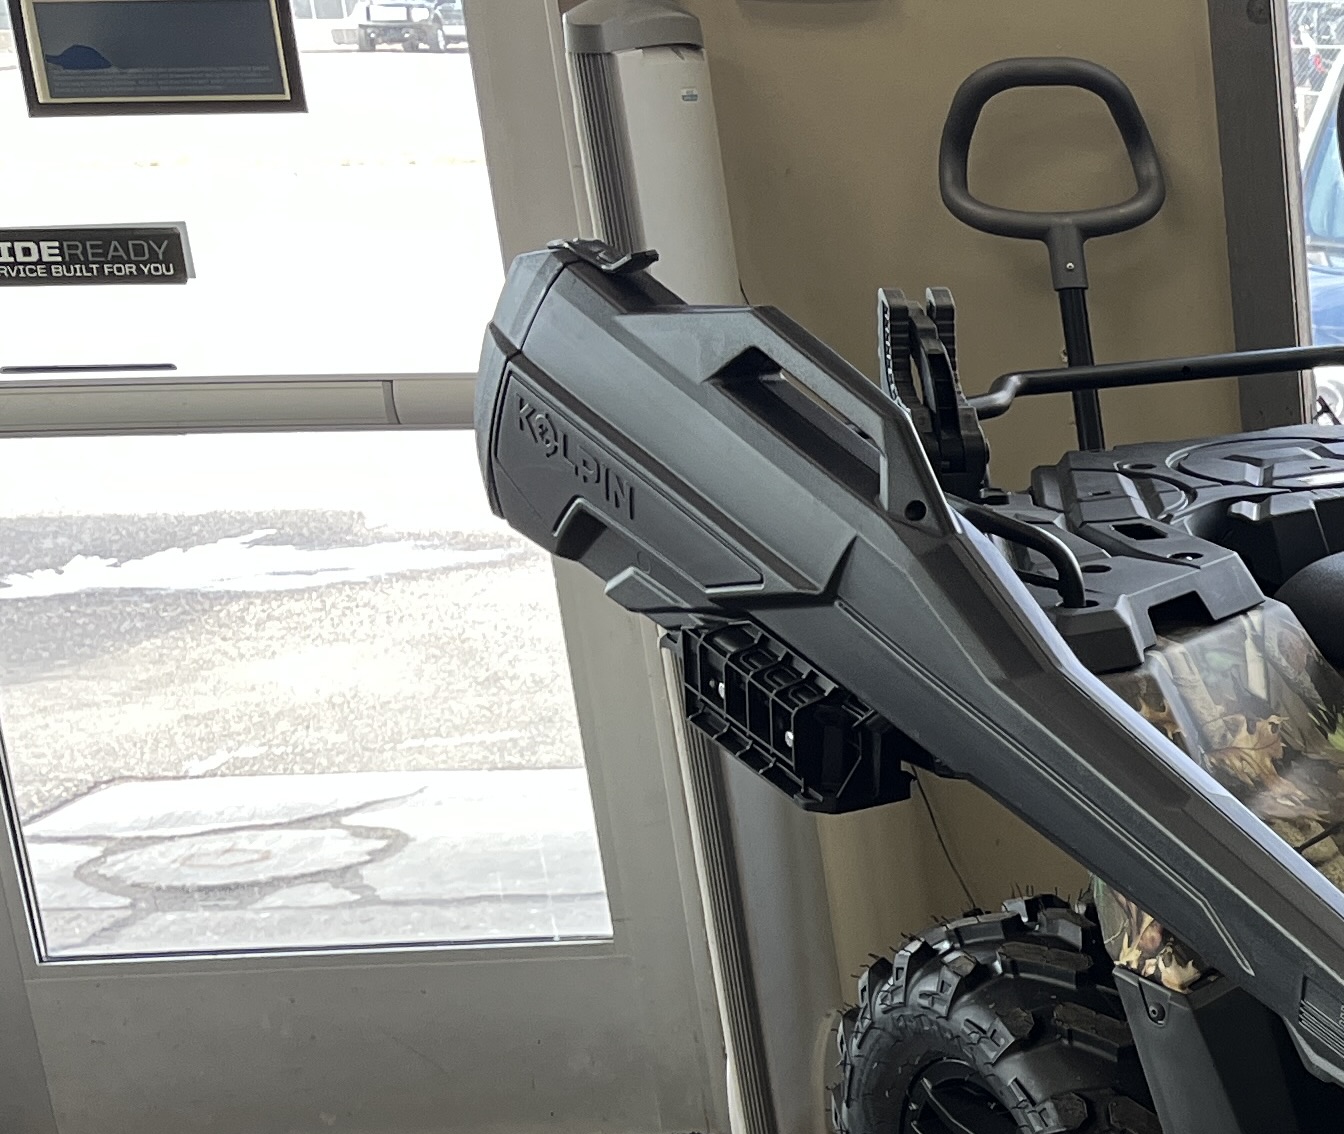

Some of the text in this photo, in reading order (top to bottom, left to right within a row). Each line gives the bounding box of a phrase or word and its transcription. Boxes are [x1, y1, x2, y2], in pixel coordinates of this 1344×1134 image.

[51, 263, 99, 276] BUILT
[104, 264, 138, 276] FOR
[140, 263, 175, 275] YOU
[516, 393, 635, 521] KOLPIN
